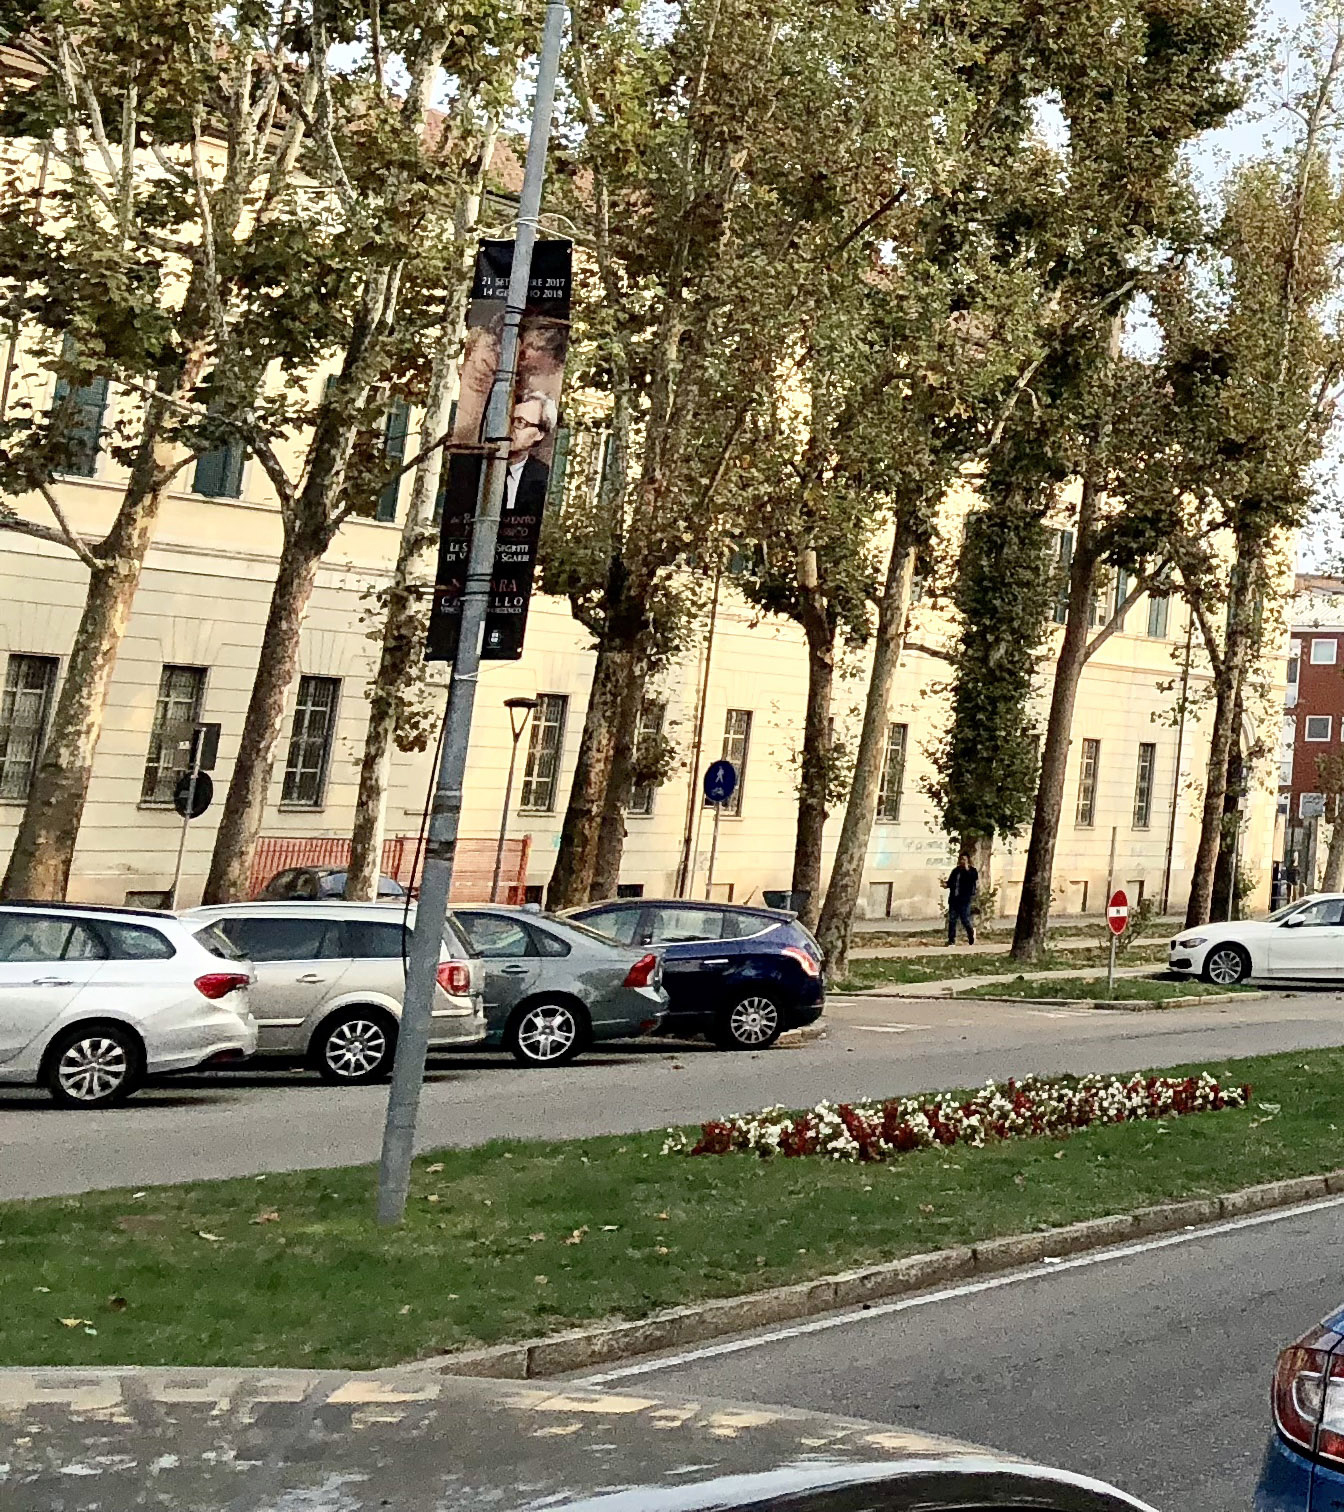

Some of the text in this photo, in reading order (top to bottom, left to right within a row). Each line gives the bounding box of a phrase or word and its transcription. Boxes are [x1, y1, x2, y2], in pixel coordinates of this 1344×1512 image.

[482, 277, 491, 285] 21
[545, 278, 565, 287] 2017
[483, 288, 493, 296] 14
